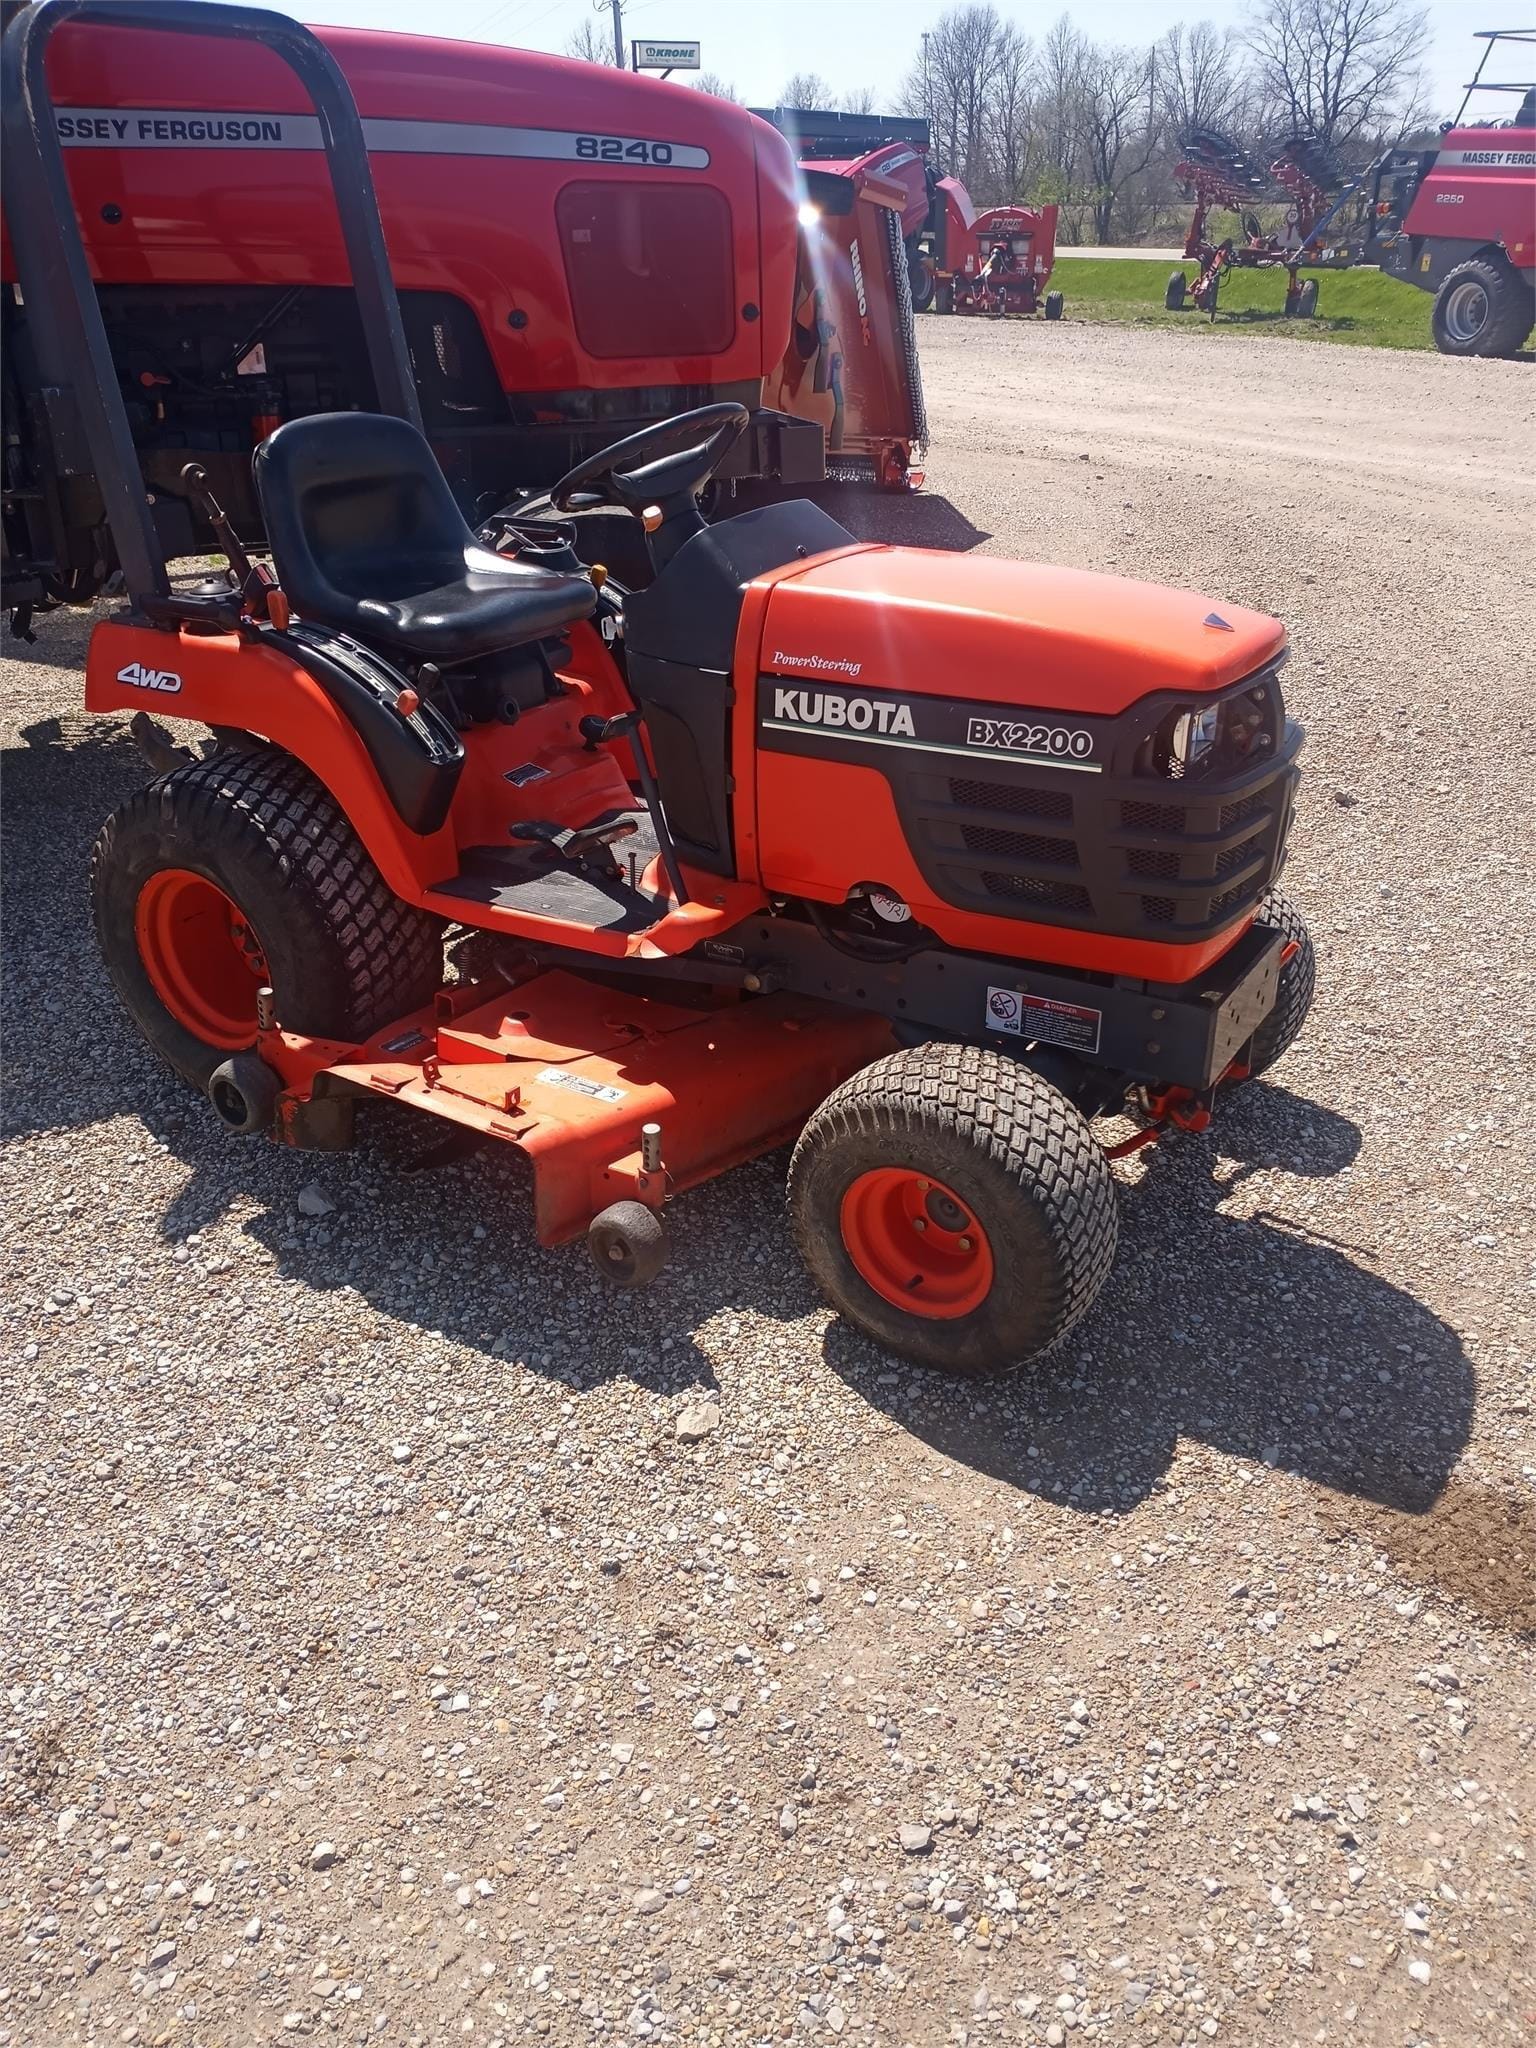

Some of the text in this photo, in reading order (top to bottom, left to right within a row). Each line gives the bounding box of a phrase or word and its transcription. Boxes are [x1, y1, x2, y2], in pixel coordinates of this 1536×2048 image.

[656, 48, 695, 58] KRONE
[137, 119, 282, 141] FERGUSON
[575, 136, 673, 165] 8240
[1462, 151, 1504, 164] MASSEY
[849, 238, 867, 316] RHINO
[117, 662, 182, 692] 4WD
[772, 651, 862, 677] PowerSteering
[774, 688, 916, 737] KUBOTA
[966, 717, 1094, 759] BX2200
[1050, 1003, 1078, 1014] DANGER
